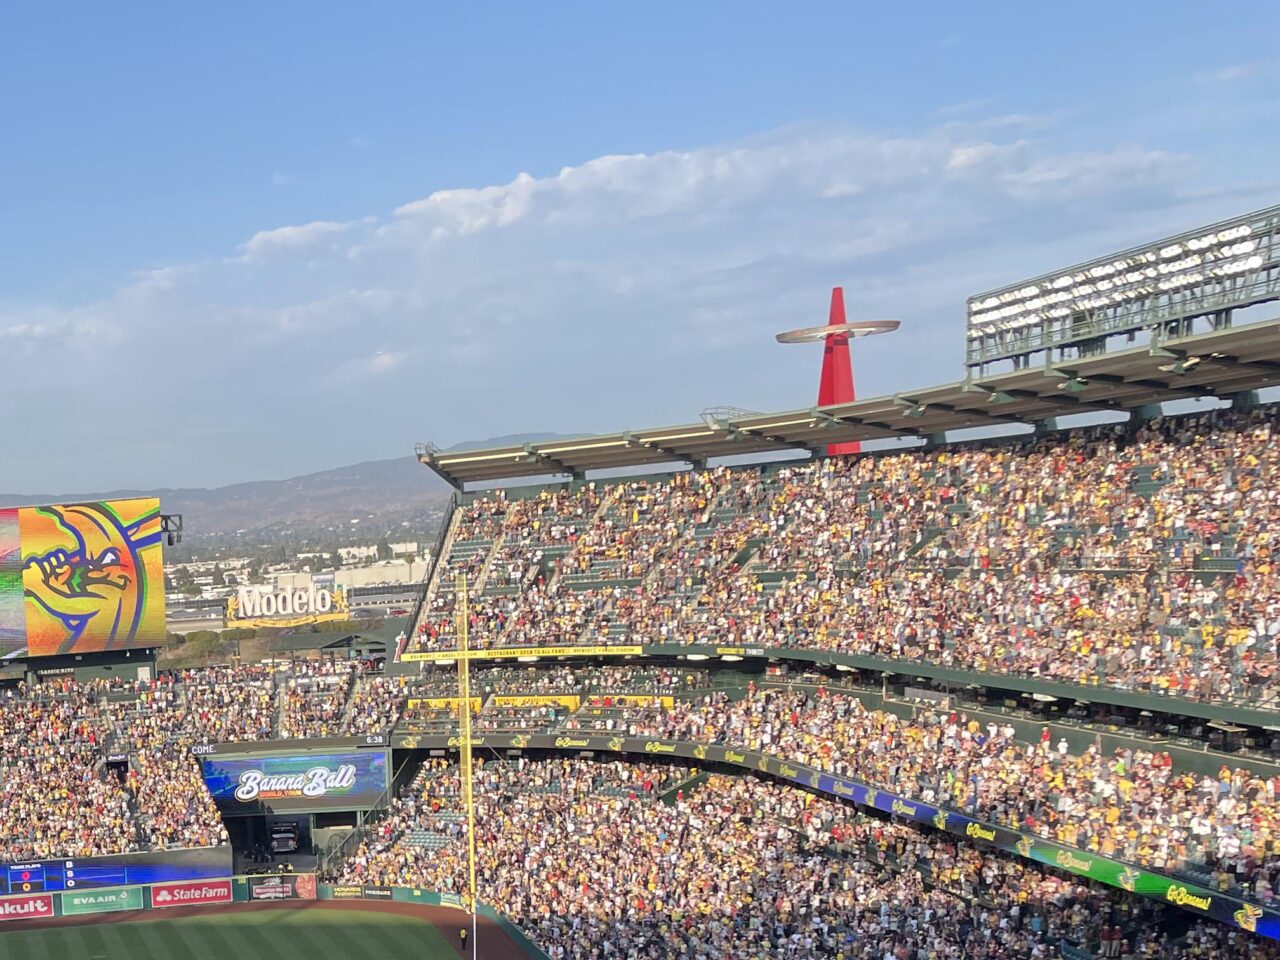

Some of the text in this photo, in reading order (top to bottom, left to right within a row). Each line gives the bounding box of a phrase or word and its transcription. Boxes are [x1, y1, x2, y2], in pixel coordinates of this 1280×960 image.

[238, 583, 332, 618] Modelo
[365, 735, 383, 744] 6:38
[191, 745, 217, 755] COME.
[236, 766, 356, 802] Banana Ball
[66, 870, 74, 878] S
[173, 887, 228, 900] State Farm
[73, 895, 117, 906] EVA AIR
